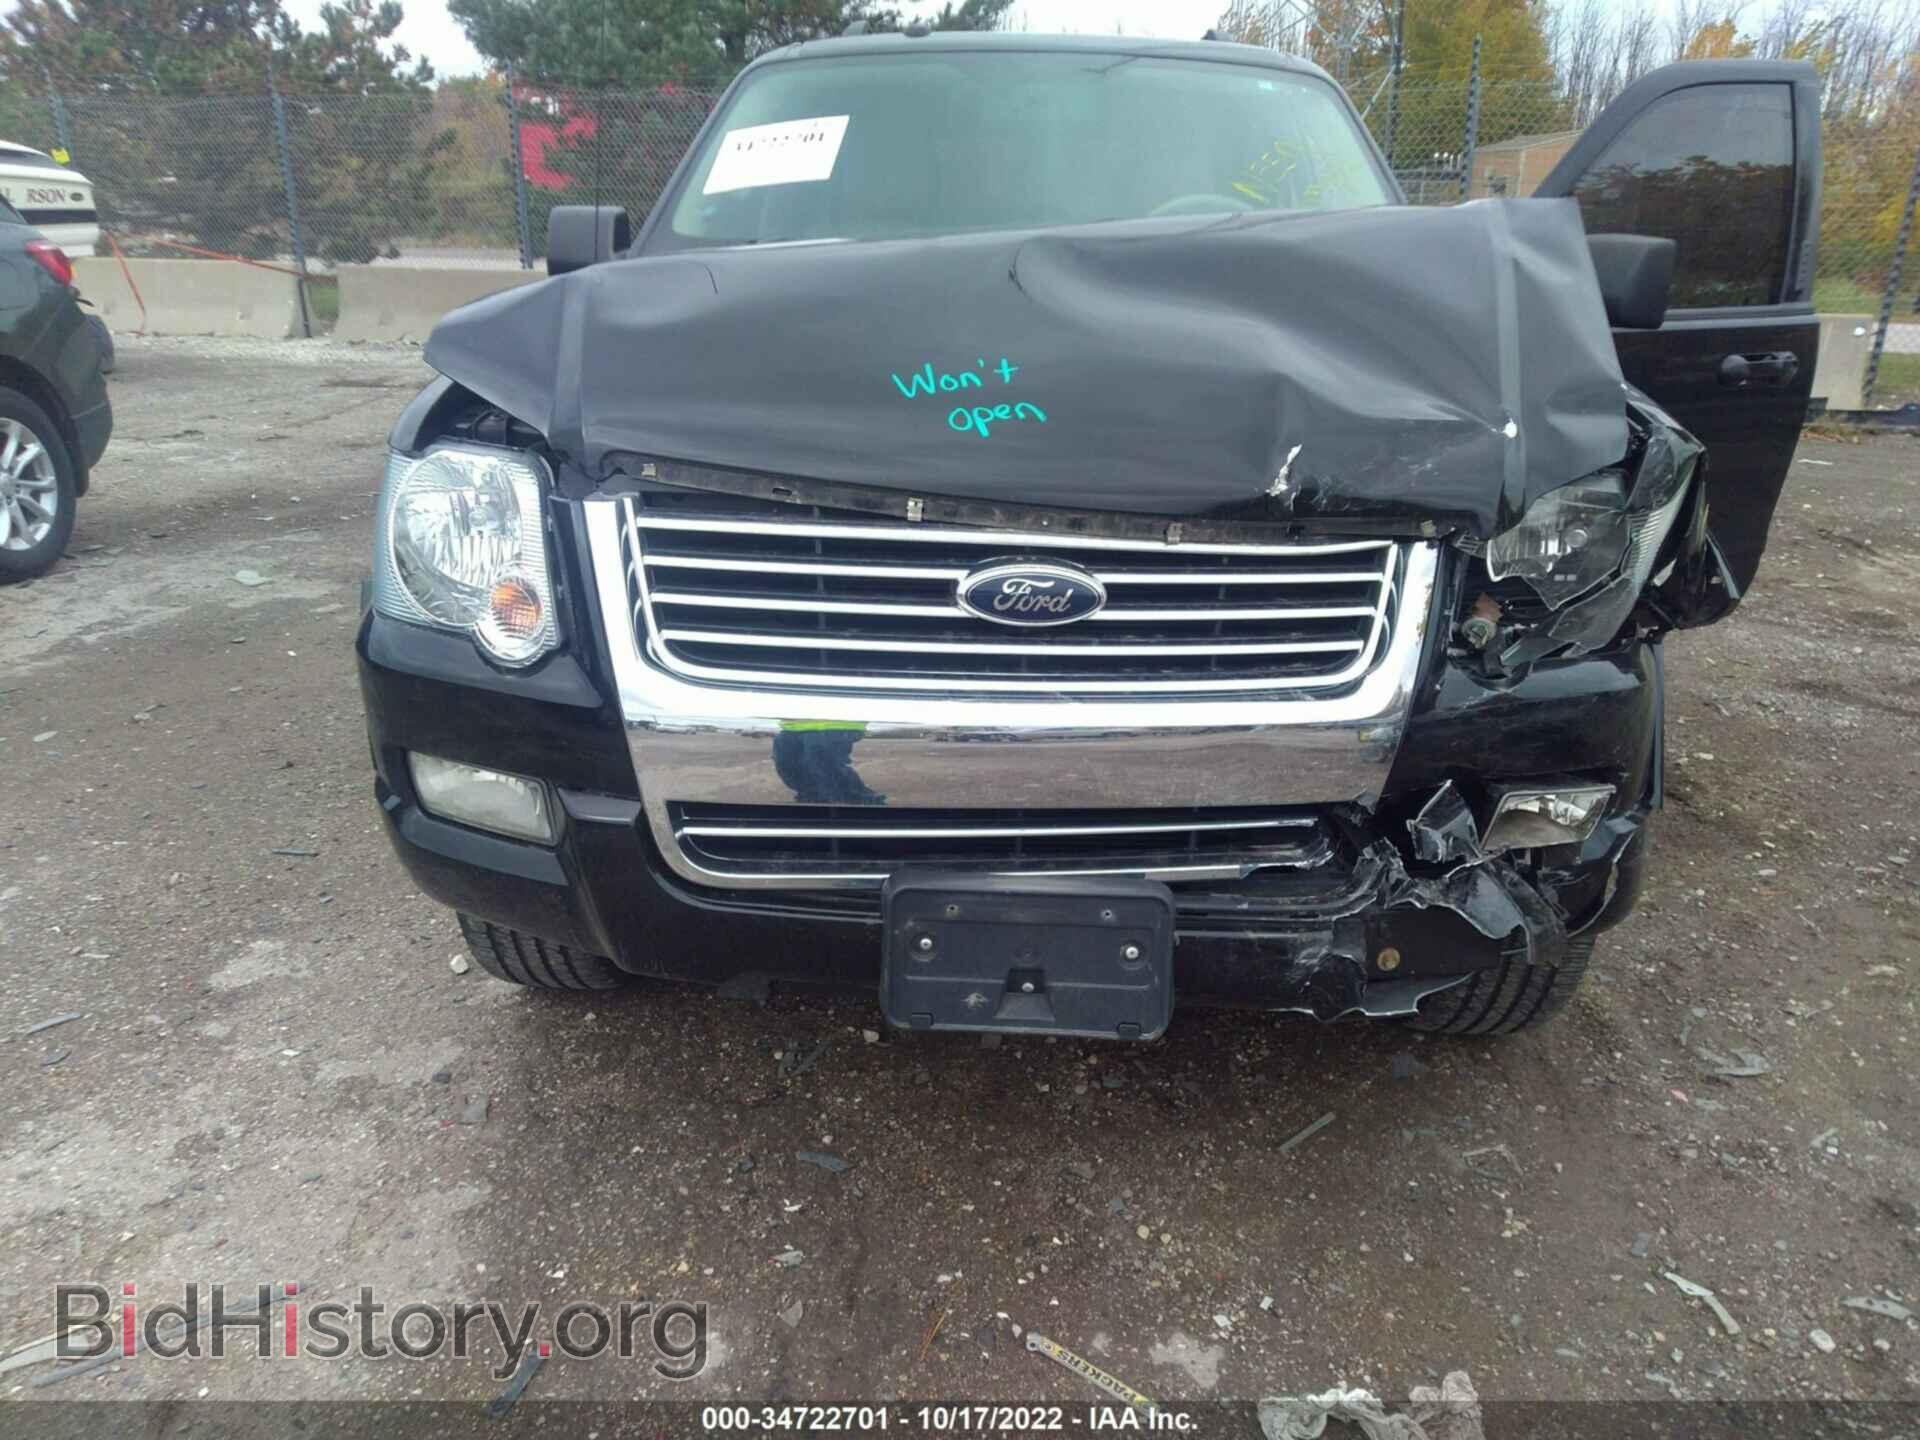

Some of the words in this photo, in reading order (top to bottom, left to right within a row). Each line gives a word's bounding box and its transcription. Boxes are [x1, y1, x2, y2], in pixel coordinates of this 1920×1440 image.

[891, 357, 1019, 399] Won't
[947, 402, 1047, 438] open
[993, 578, 1074, 613] Ford
